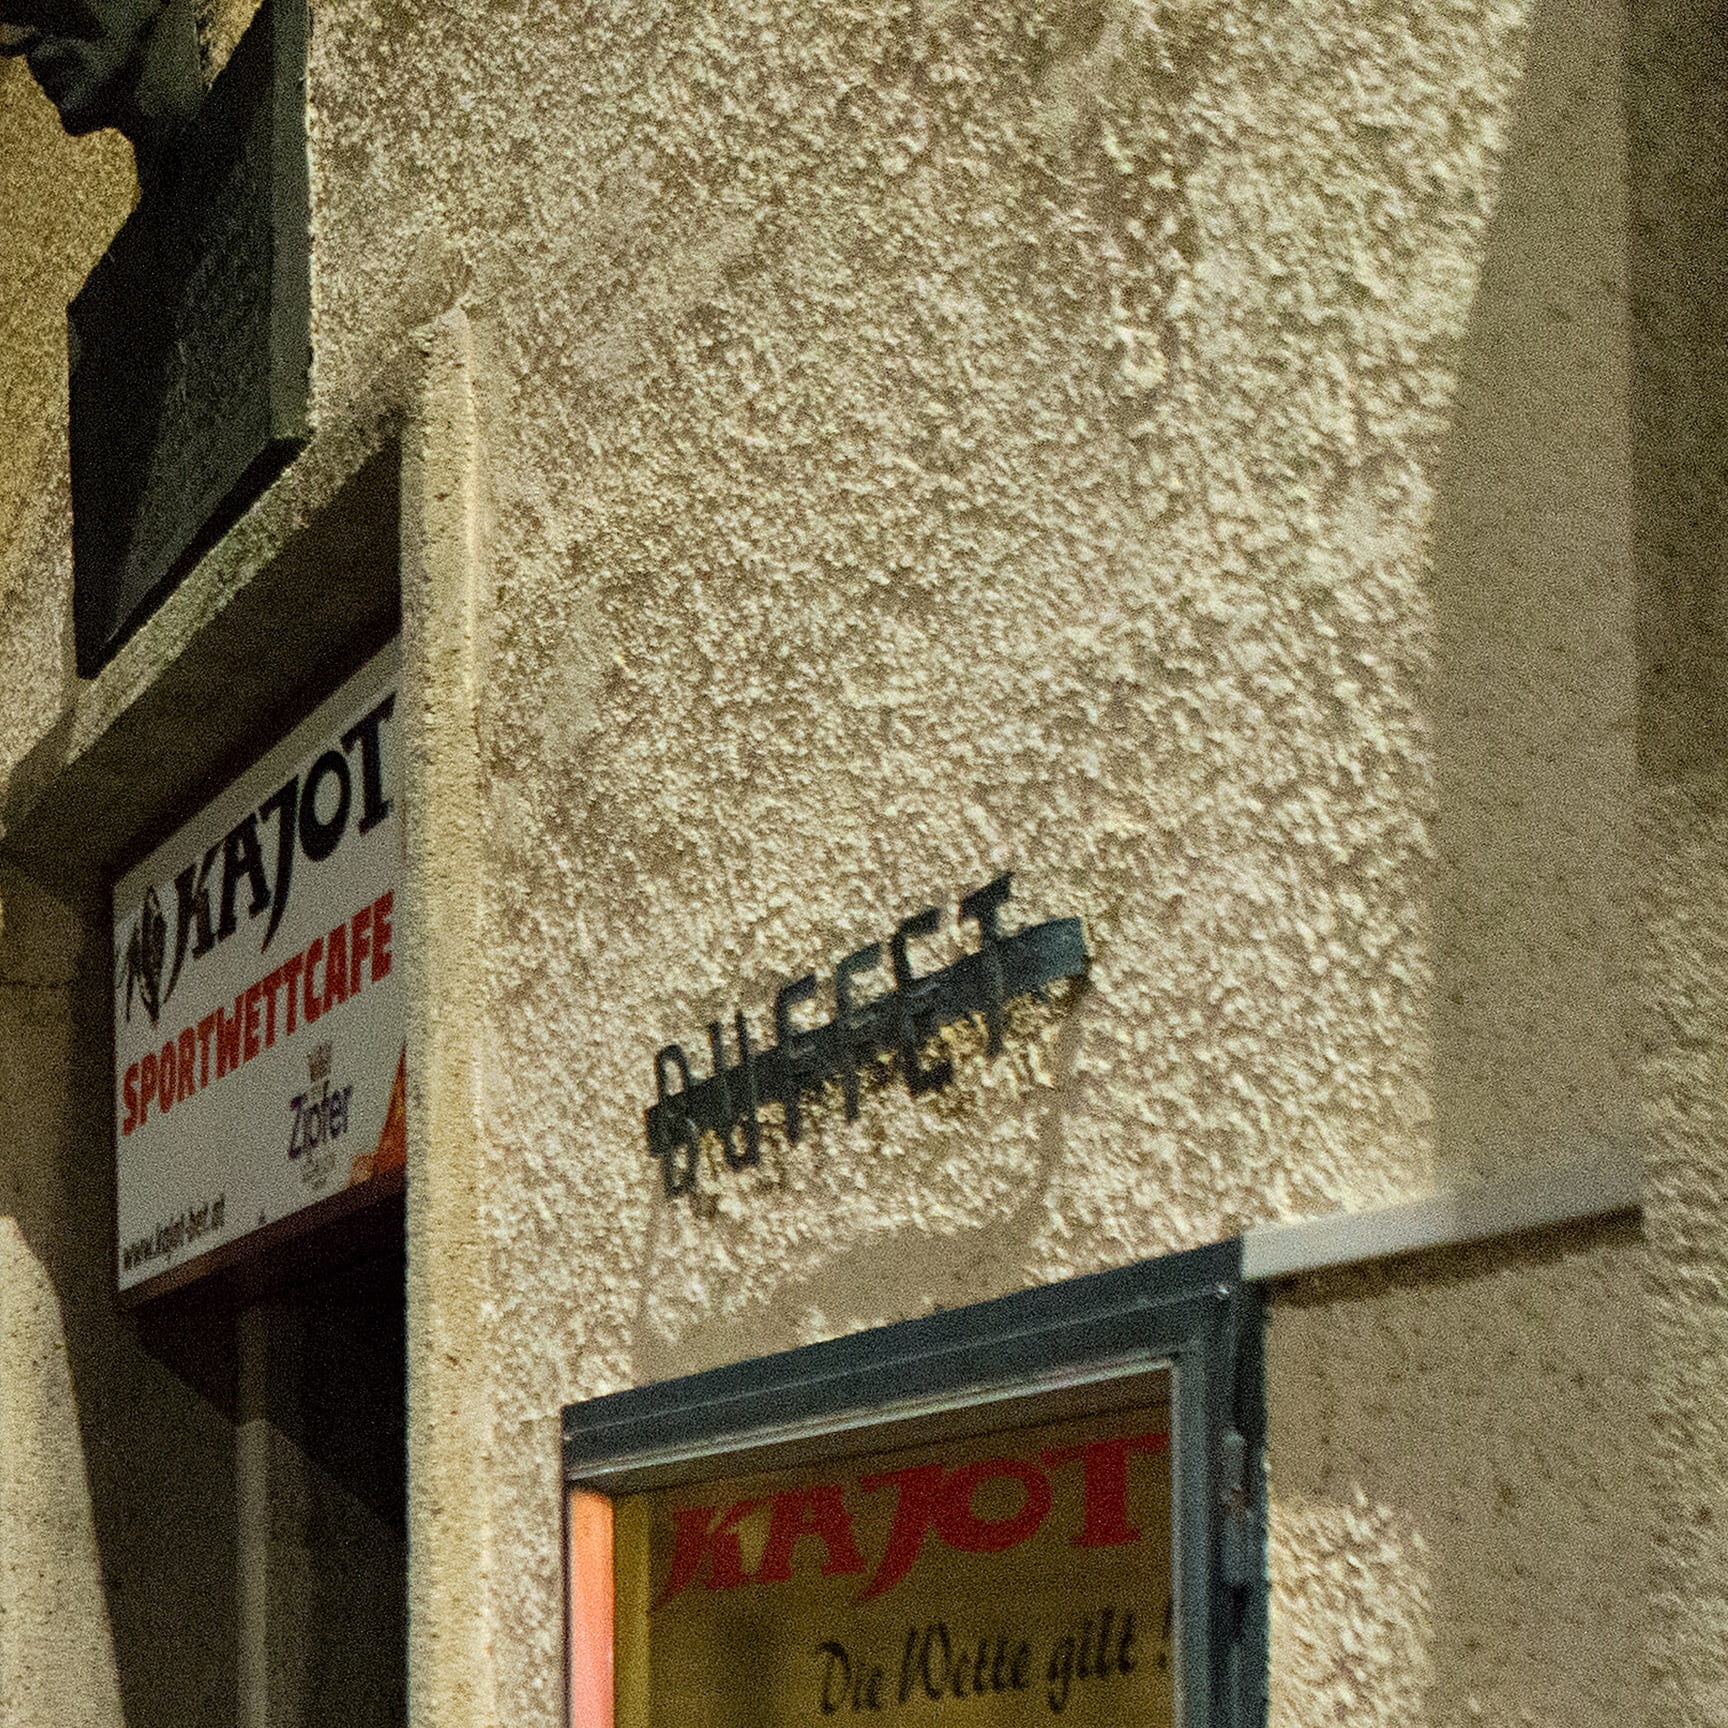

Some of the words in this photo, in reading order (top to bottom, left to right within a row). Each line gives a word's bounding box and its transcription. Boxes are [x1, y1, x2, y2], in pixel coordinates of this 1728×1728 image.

[158, 690, 398, 1005] KAJOT
[121, 890, 394, 1137] SPORTWETTCAFE
[287, 1080, 353, 1162] Zipfer
[651, 1432, 1169, 1611] KAJOT
[819, 1640, 884, 1715] Die
[898, 1622, 1032, 1704] Wette
[1046, 1608, 1135, 1714] gilt
